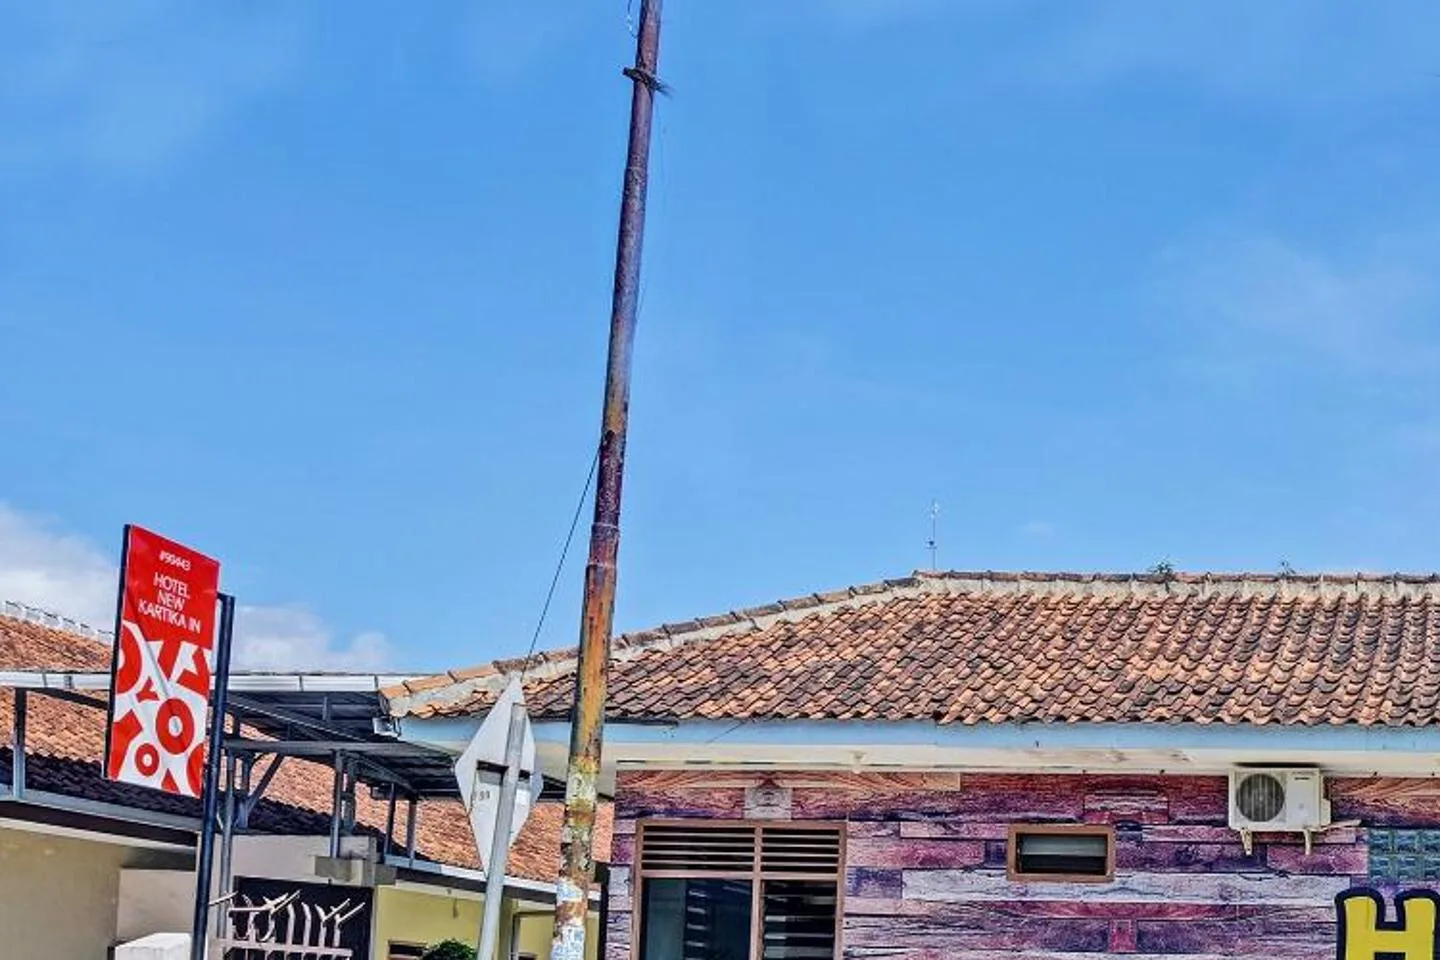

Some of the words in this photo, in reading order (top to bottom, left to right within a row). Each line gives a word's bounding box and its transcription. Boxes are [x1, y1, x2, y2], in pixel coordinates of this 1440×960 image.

[153, 571, 191, 600] HOTEL
[157, 589, 185, 611] NEW
[138, 598, 187, 630] KARTIKA
[187, 616, 201, 634] IN
